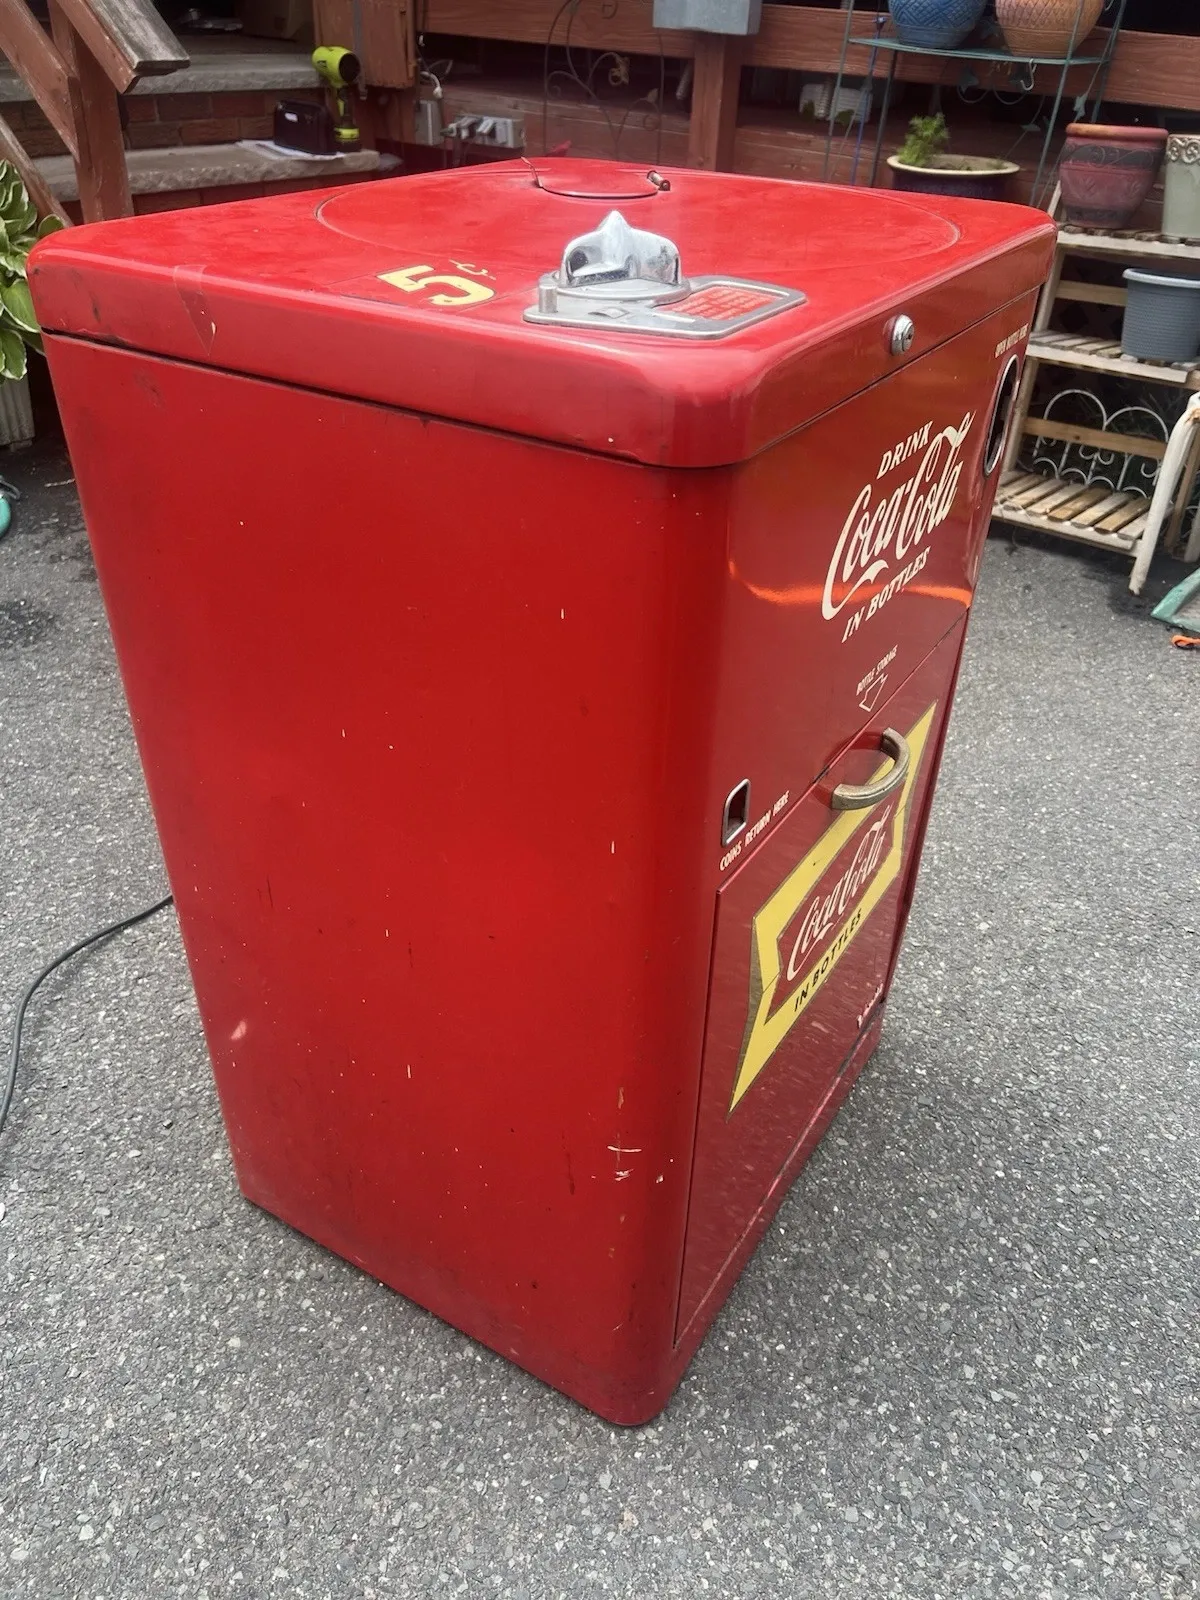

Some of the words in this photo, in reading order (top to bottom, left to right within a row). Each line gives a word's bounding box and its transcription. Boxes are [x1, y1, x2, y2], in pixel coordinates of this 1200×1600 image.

[876, 420, 933, 480] DRINK
[822, 410, 977, 621] Coca-Cola
[841, 606, 866, 643] IN
[865, 546, 931, 621] BOTTLES
[719, 840, 742, 871] COINS
[744, 809, 772, 847] RETURN
[772, 790, 790, 817] HERE
[787, 801, 895, 982] Coca-Cola
[794, 984, 811, 1012] IN
[812, 907, 862, 988] BOTTLES
